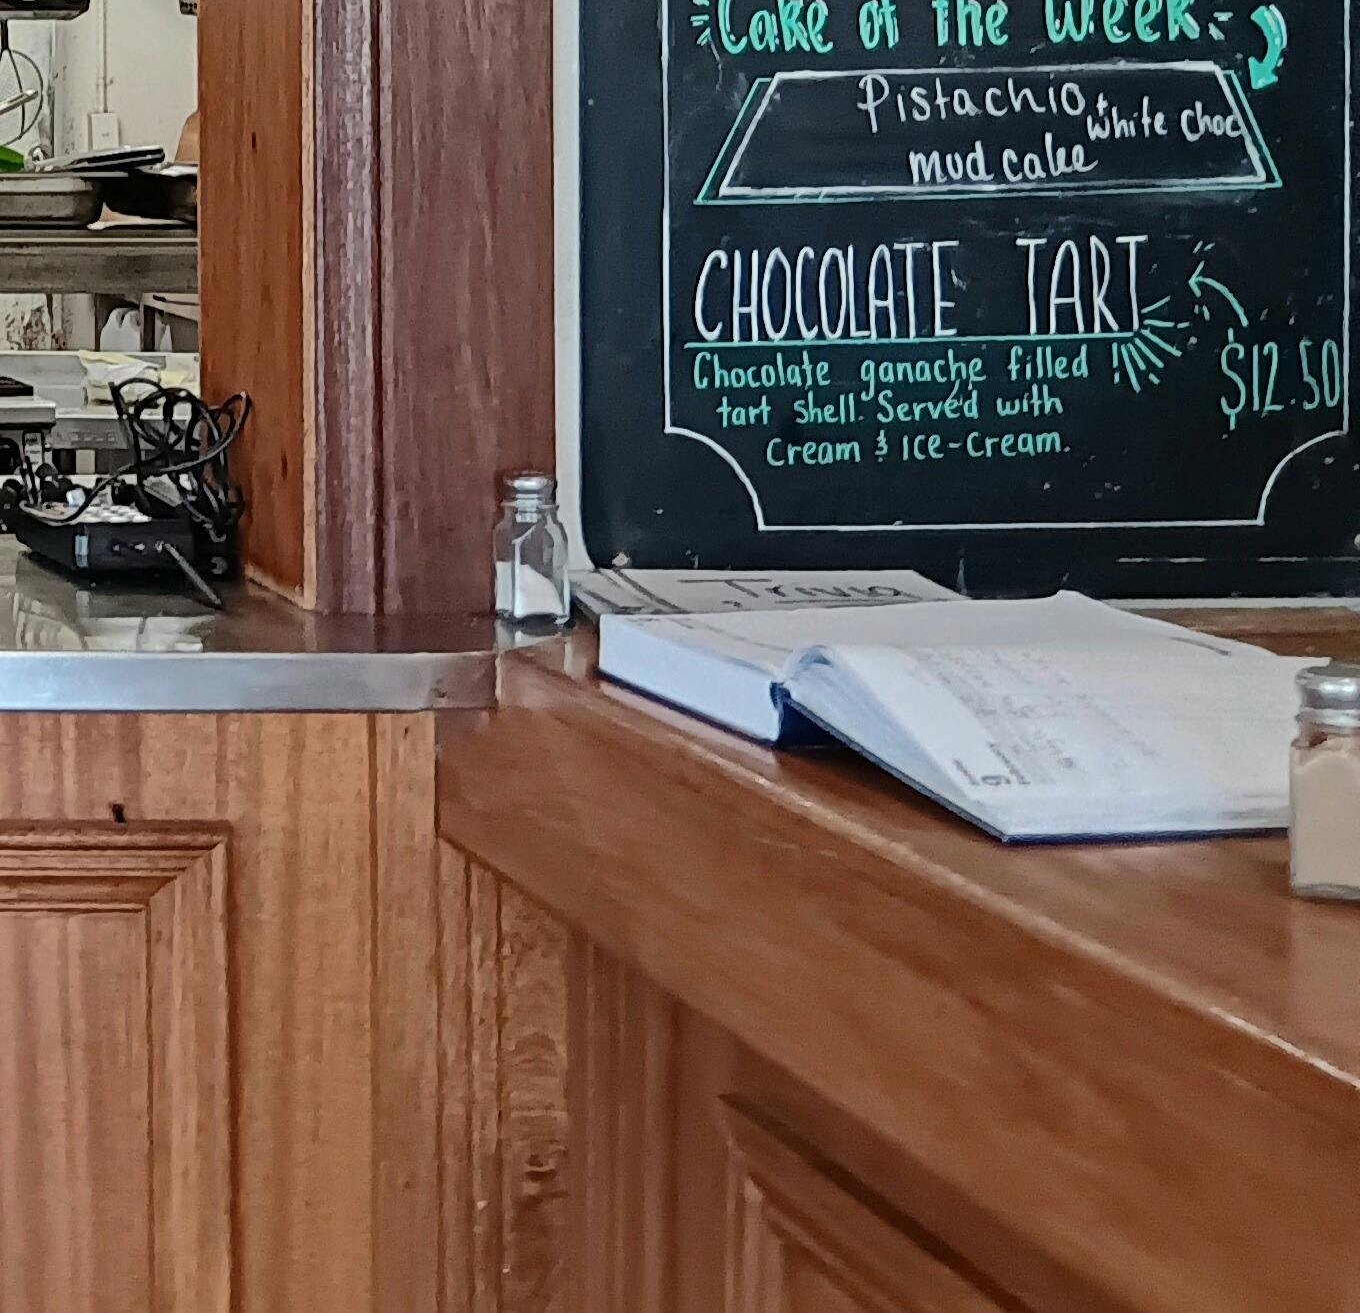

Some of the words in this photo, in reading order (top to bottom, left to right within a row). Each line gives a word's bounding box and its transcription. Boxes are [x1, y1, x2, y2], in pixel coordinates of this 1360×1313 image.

[857, 73, 1086, 134] Pistachio
[1002, 132, 1100, 183] cake
[693, 240, 960, 342] CHOCOLATE
[1016, 235, 1149, 337] TART
[692, 349, 832, 390] Chocolate
[860, 351, 986, 400] ganache
[1007, 345, 1090, 381] filled
[1219, 328, 1340, 431] $12.50
[716, 397, 772, 428] tart
[876, 386, 980, 424] Served
[995, 389, 1065, 417] with
[766, 437, 862, 467] Cream
[677, 577, 922, 601] Trivia
